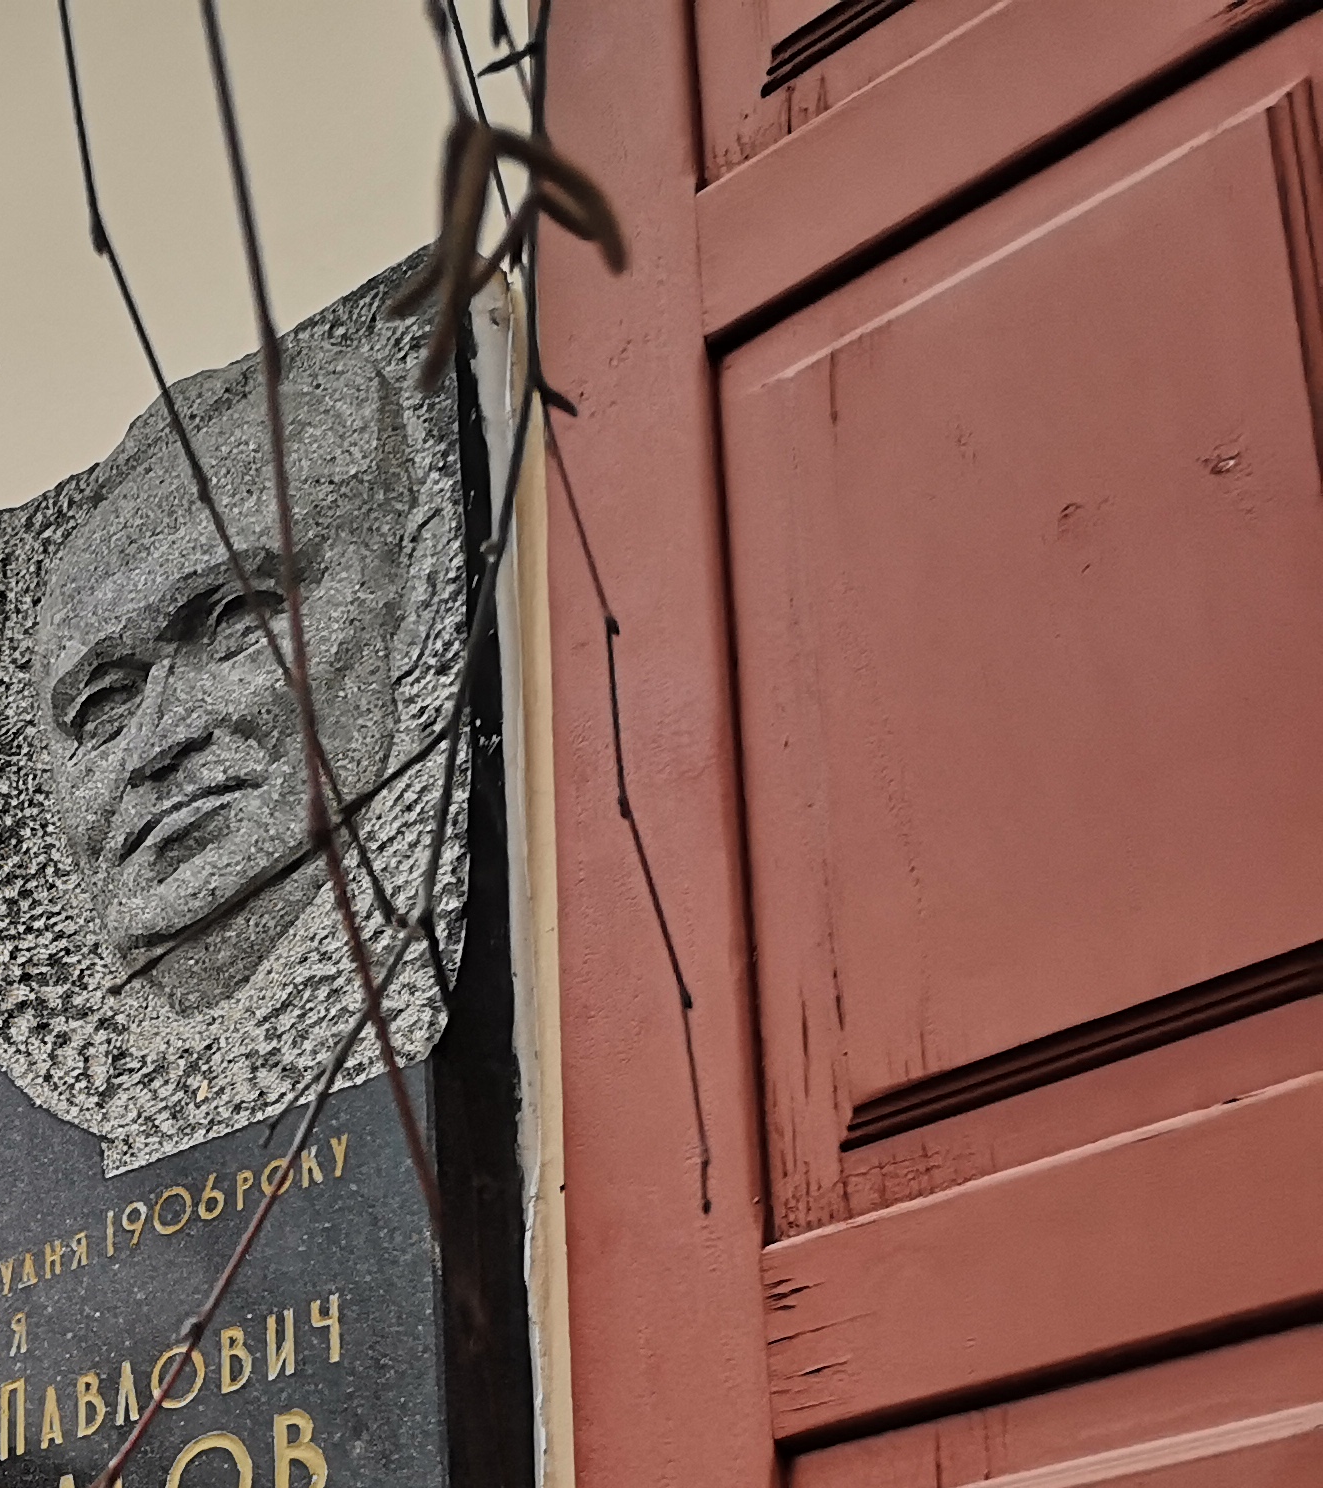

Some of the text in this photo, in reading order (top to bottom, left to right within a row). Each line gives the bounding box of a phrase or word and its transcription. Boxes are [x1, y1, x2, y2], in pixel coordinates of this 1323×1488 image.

[105, 1176, 225, 1257] 1906
[236, 1132, 349, 1212] РОКУ
[0, 1293, 341, 1461] ПАВЛОВИЧ
